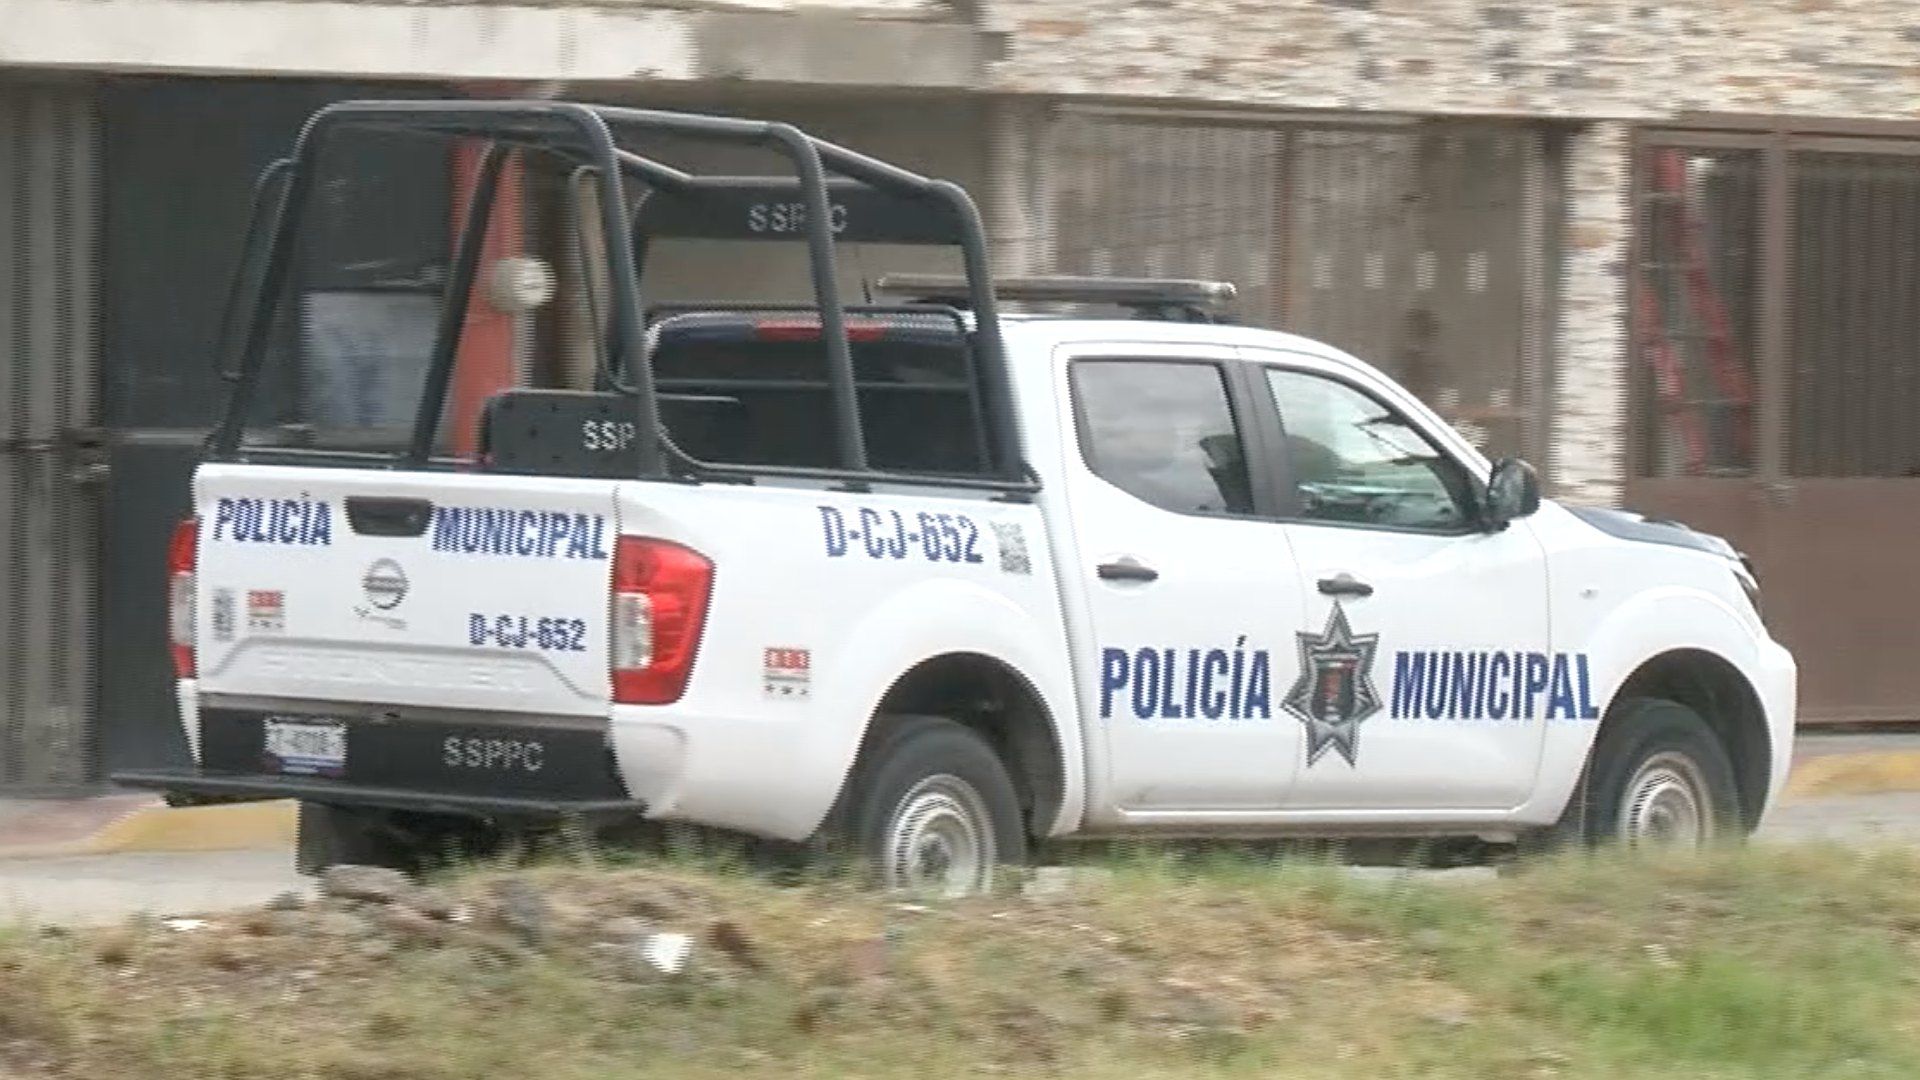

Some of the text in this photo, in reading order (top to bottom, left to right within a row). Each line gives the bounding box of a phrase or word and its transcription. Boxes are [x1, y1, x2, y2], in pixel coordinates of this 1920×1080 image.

[748, 203, 848, 232] SSPC
[213, 490, 609, 560] POLICÍA MUNICIPAL
[817, 506, 984, 562] D-CJ-652
[468, 613, 587, 651] D-CJ-652
[1100, 635, 1600, 720] POLICÍA MUNICIPAL
[444, 736, 544, 771] SSPPC
